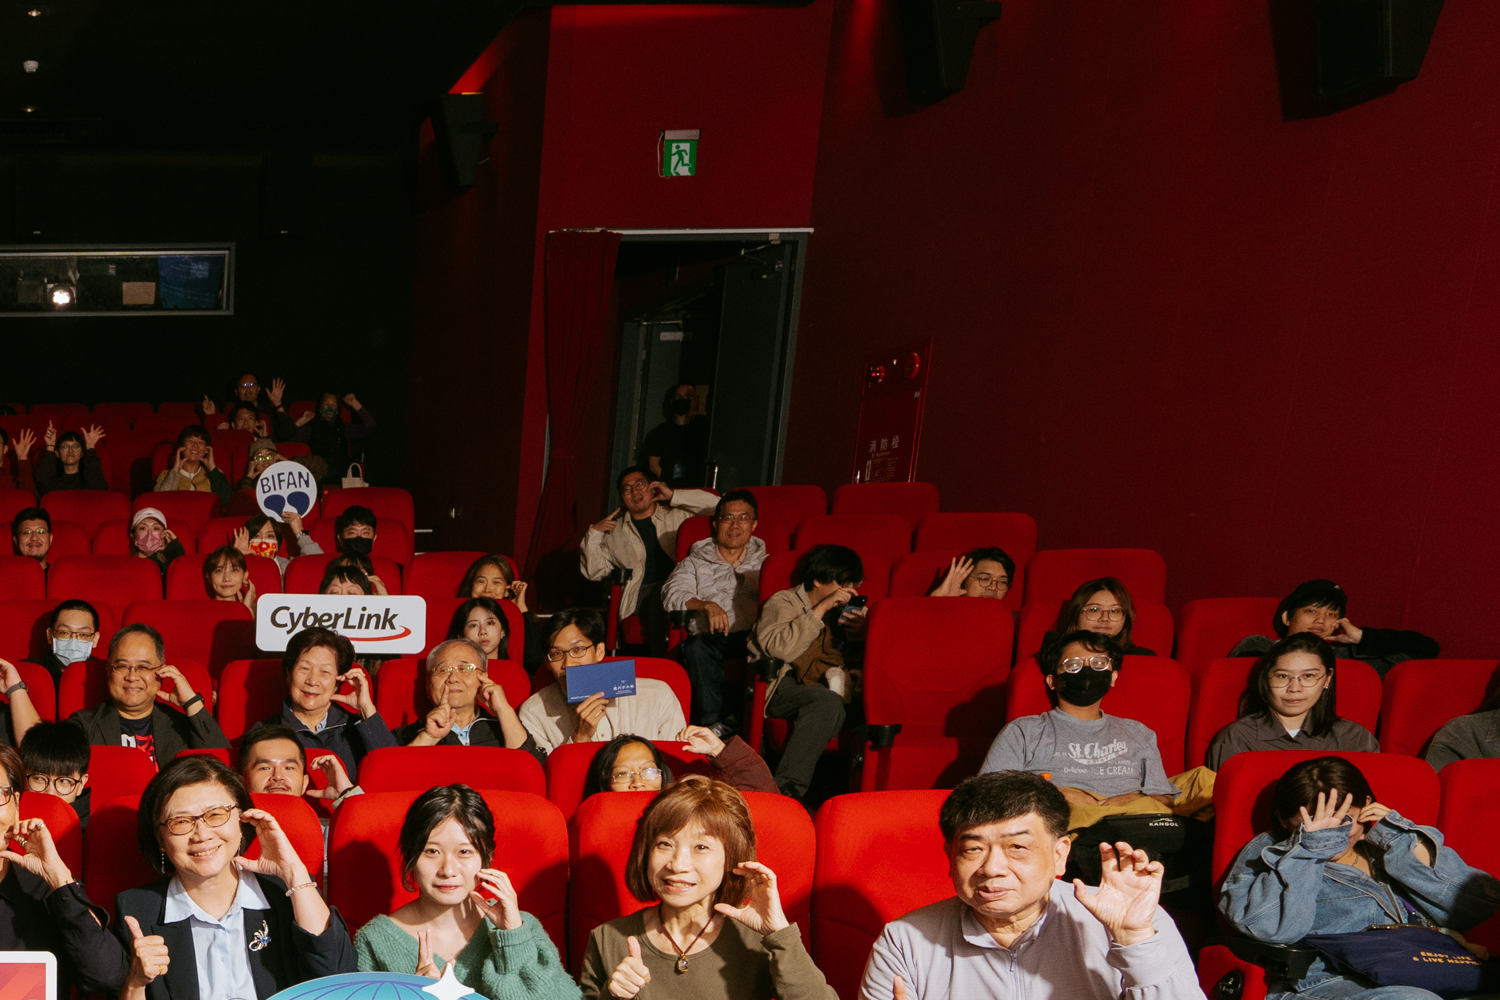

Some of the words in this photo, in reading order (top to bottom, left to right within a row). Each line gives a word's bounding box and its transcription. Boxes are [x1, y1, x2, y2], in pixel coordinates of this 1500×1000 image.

[260, 471, 310, 494] BIFAN
[270, 605, 399, 635] CyberLink
[1084, 738, 1128, 759] Charles
[1106, 765, 1134, 776] CREAM
[1447, 958, 1483, 966] HAPPIL
